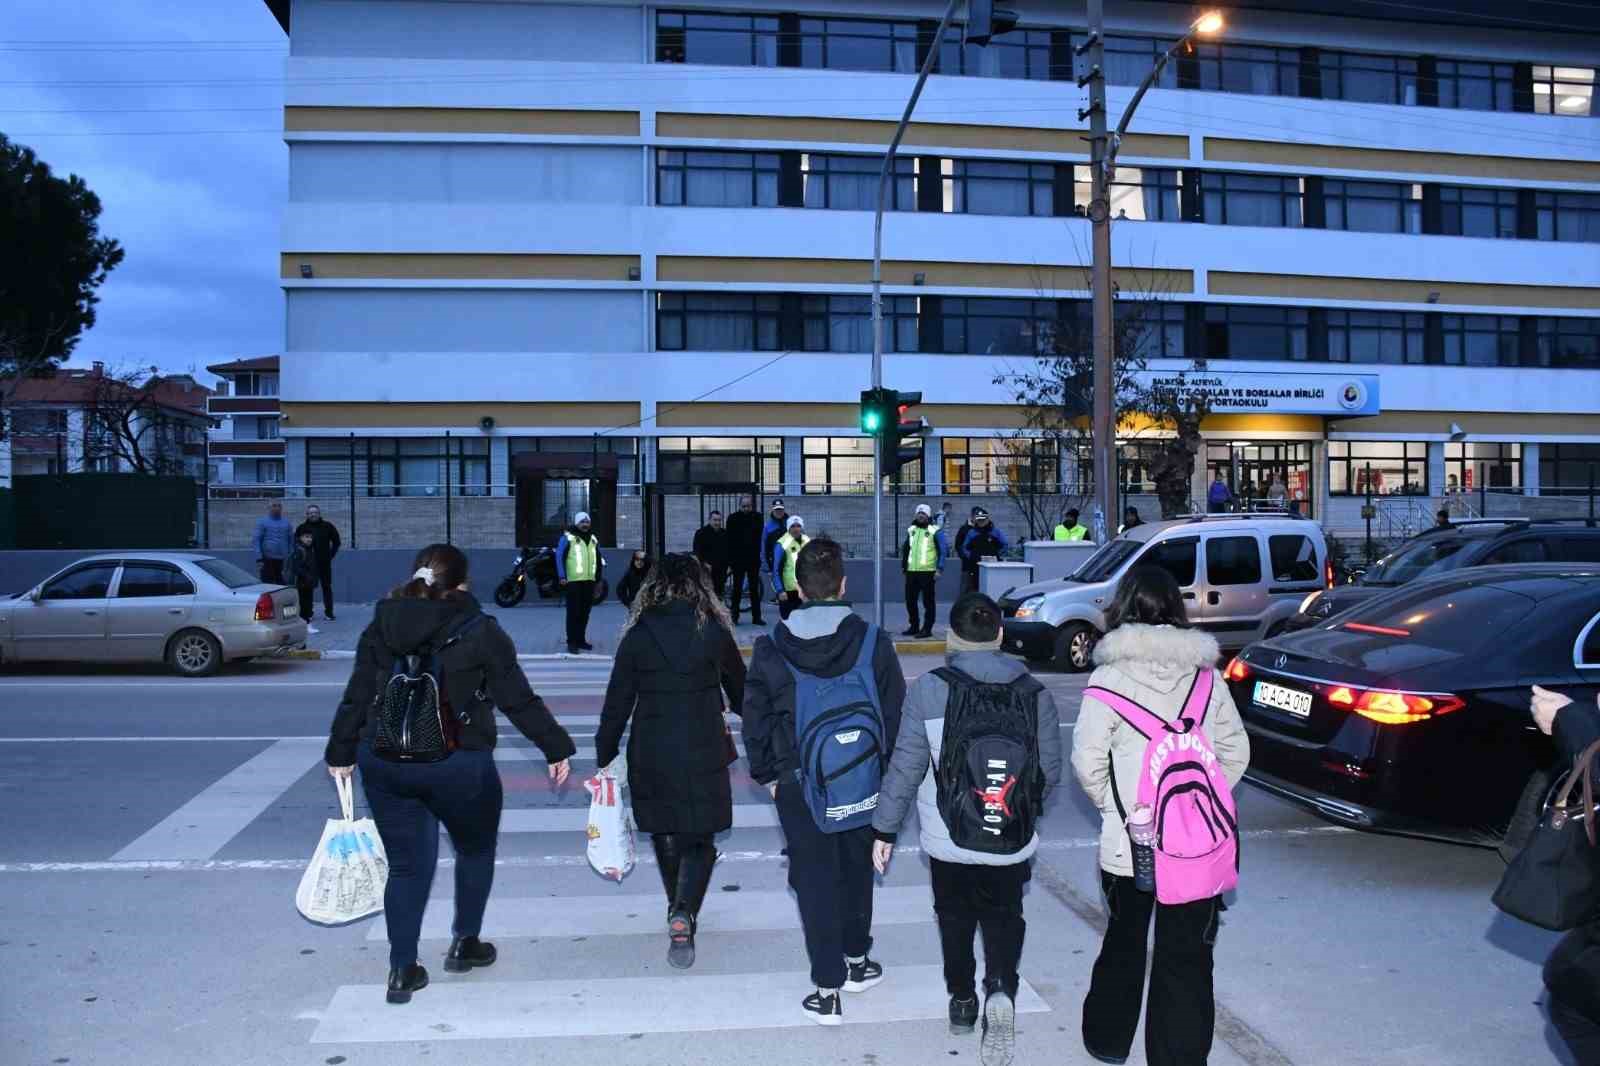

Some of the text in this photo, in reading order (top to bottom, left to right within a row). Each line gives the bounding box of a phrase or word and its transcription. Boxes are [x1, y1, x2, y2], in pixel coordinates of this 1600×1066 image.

[1232, 388, 1244, 397] VE
[1246, 389, 1292, 398] BORSALAR
[1215, 398, 1268, 407] ORTAOKULU
[1261, 685, 1310, 712] 10 ACA 010
[1149, 733, 1176, 786] JUST
[1178, 732, 1202, 752] DO
